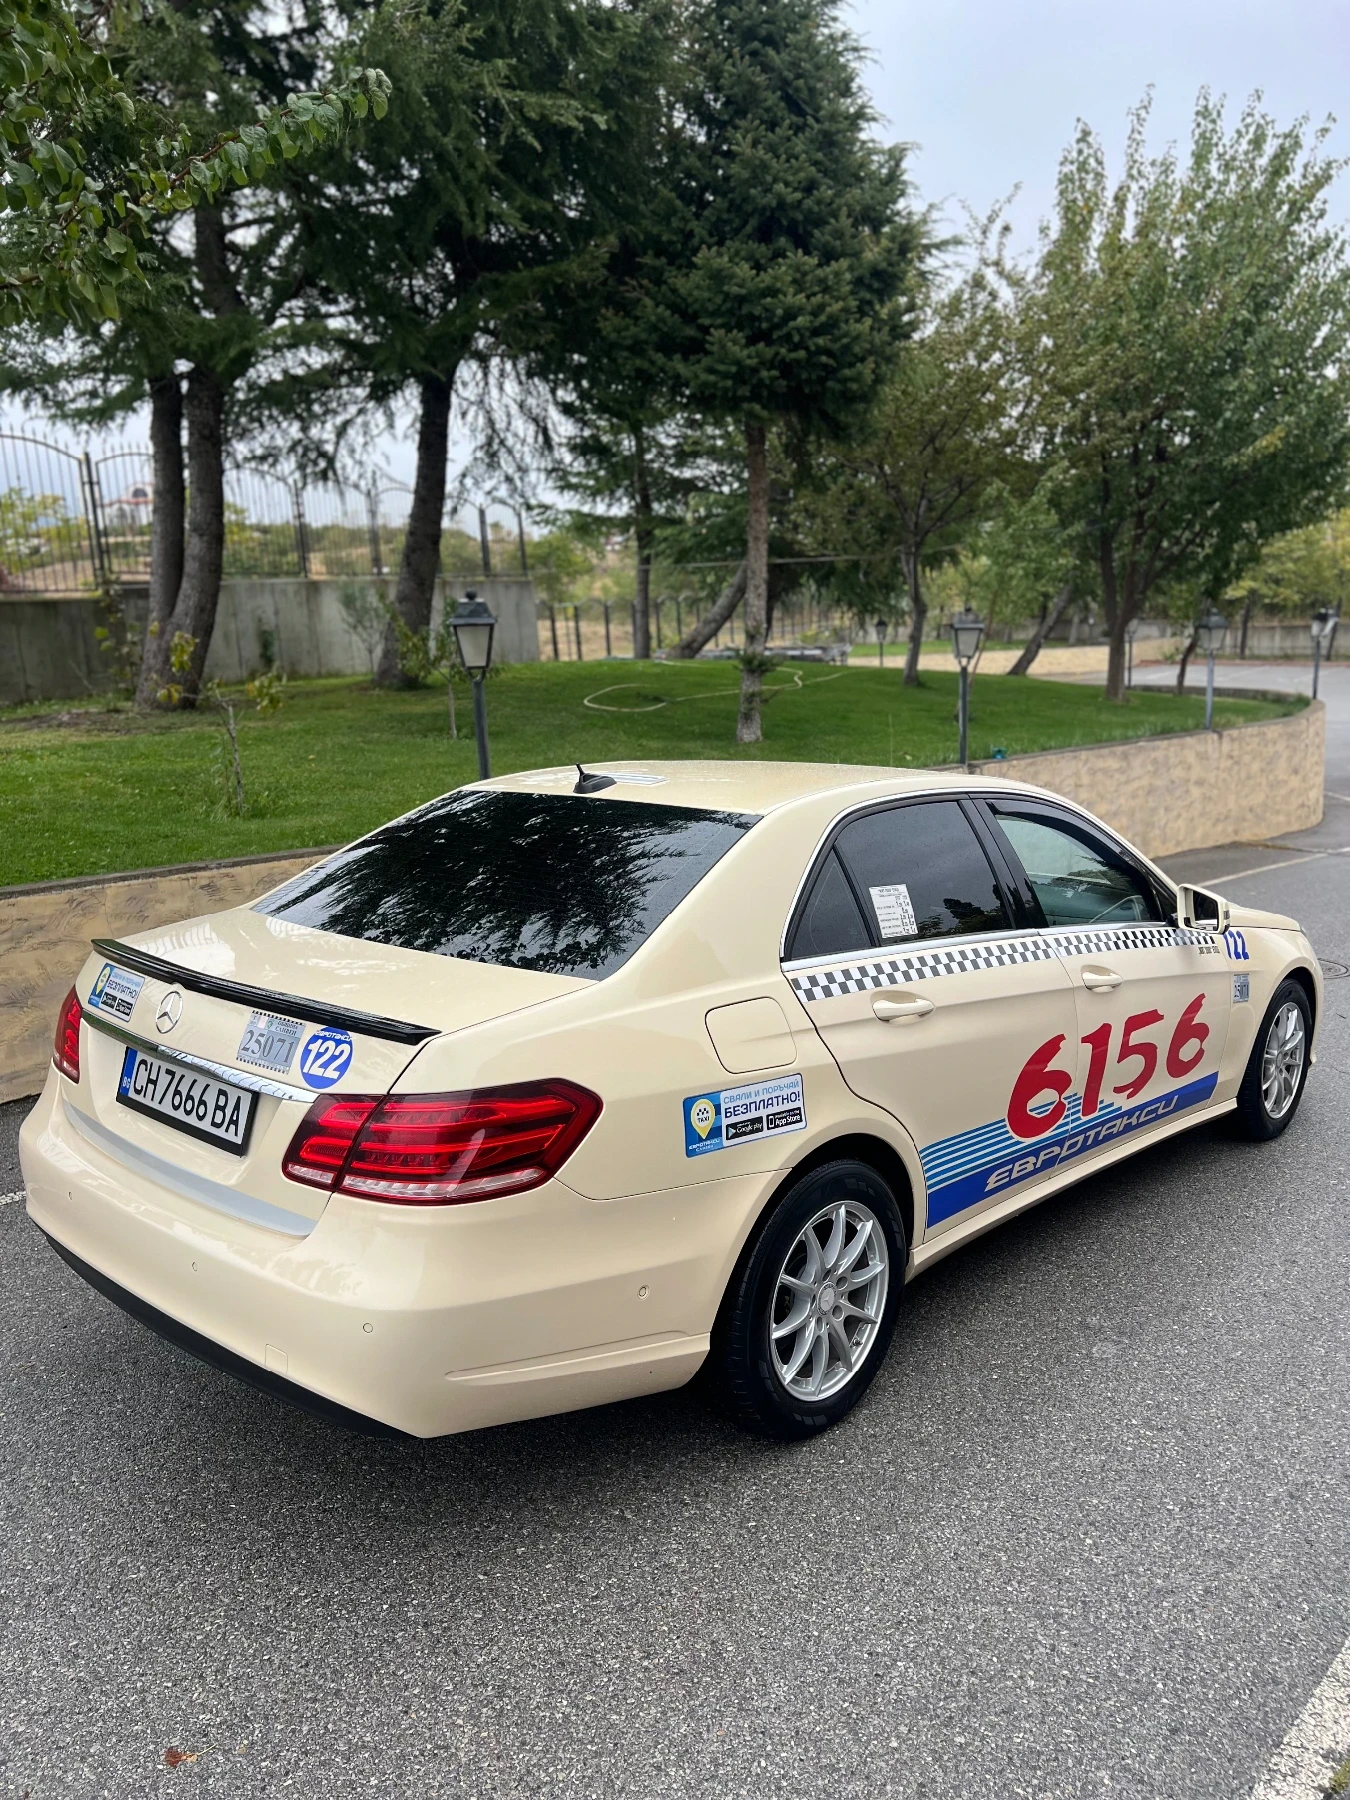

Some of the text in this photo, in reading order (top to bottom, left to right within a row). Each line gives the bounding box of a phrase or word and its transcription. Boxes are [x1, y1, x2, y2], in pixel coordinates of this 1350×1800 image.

[1223, 930, 1249, 961] 122
[241, 1030, 295, 1063] 25071
[302, 1039, 351, 1080] 122
[1007, 992, 1210, 1139] 6156
[723, 1078, 800, 1105] СВАЛИ И ПОРЪЧАЙ
[724, 1090, 801, 1119] БЕЗПЛАТНО!
[697, 1115, 710, 1123] TAXI
[736, 1124, 753, 1134] Google
[753, 1122, 763, 1131] play
[775, 1118, 787, 1127] App
[786, 1114, 801, 1123] Store
